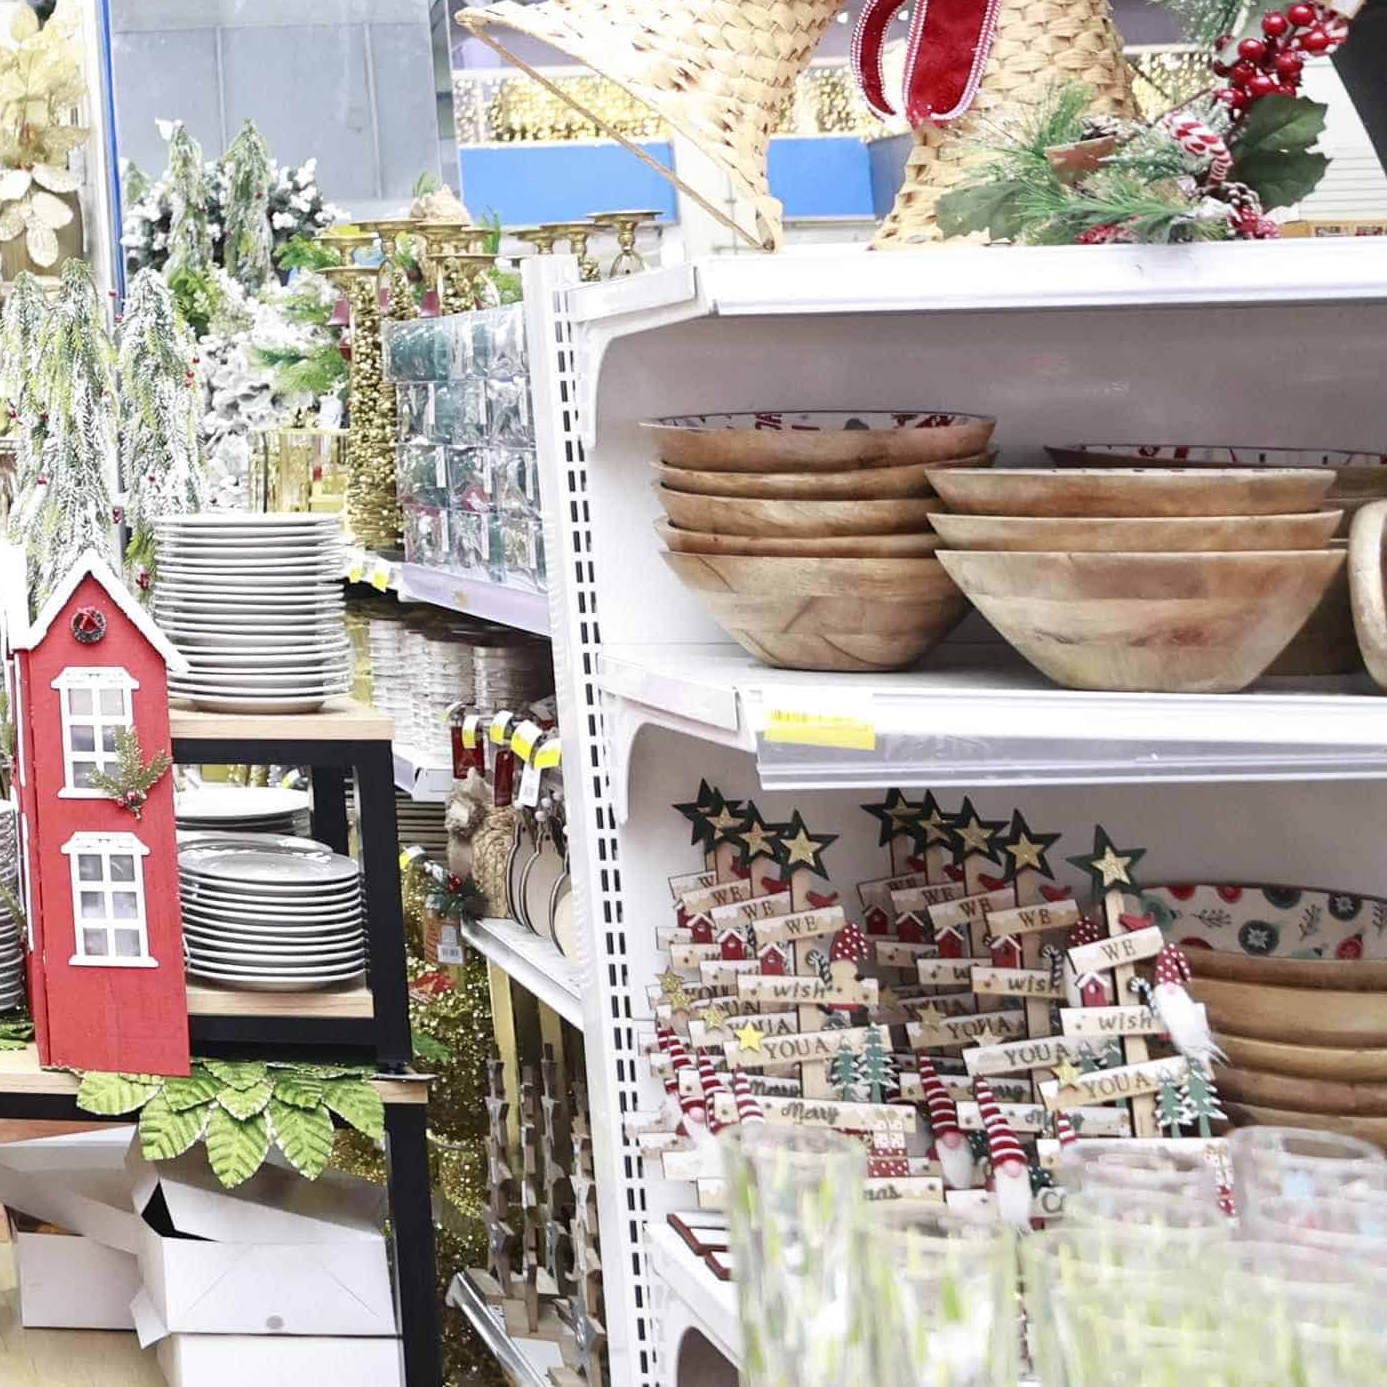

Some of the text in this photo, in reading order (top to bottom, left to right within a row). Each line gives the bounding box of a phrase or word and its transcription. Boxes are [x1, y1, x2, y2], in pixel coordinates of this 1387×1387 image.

[785, 915, 819, 935] WE
[1018, 908, 1052, 929] WE
[1100, 939, 1137, 962] WE
[772, 981, 828, 999] wish
[1098, 1012, 1154, 1032] wish
[763, 1036, 830, 1061] YOU A
[1004, 1044, 1052, 1066] YOU
[1083, 1070, 1151, 1098] YOU A
[781, 1102, 840, 1126] Merry
